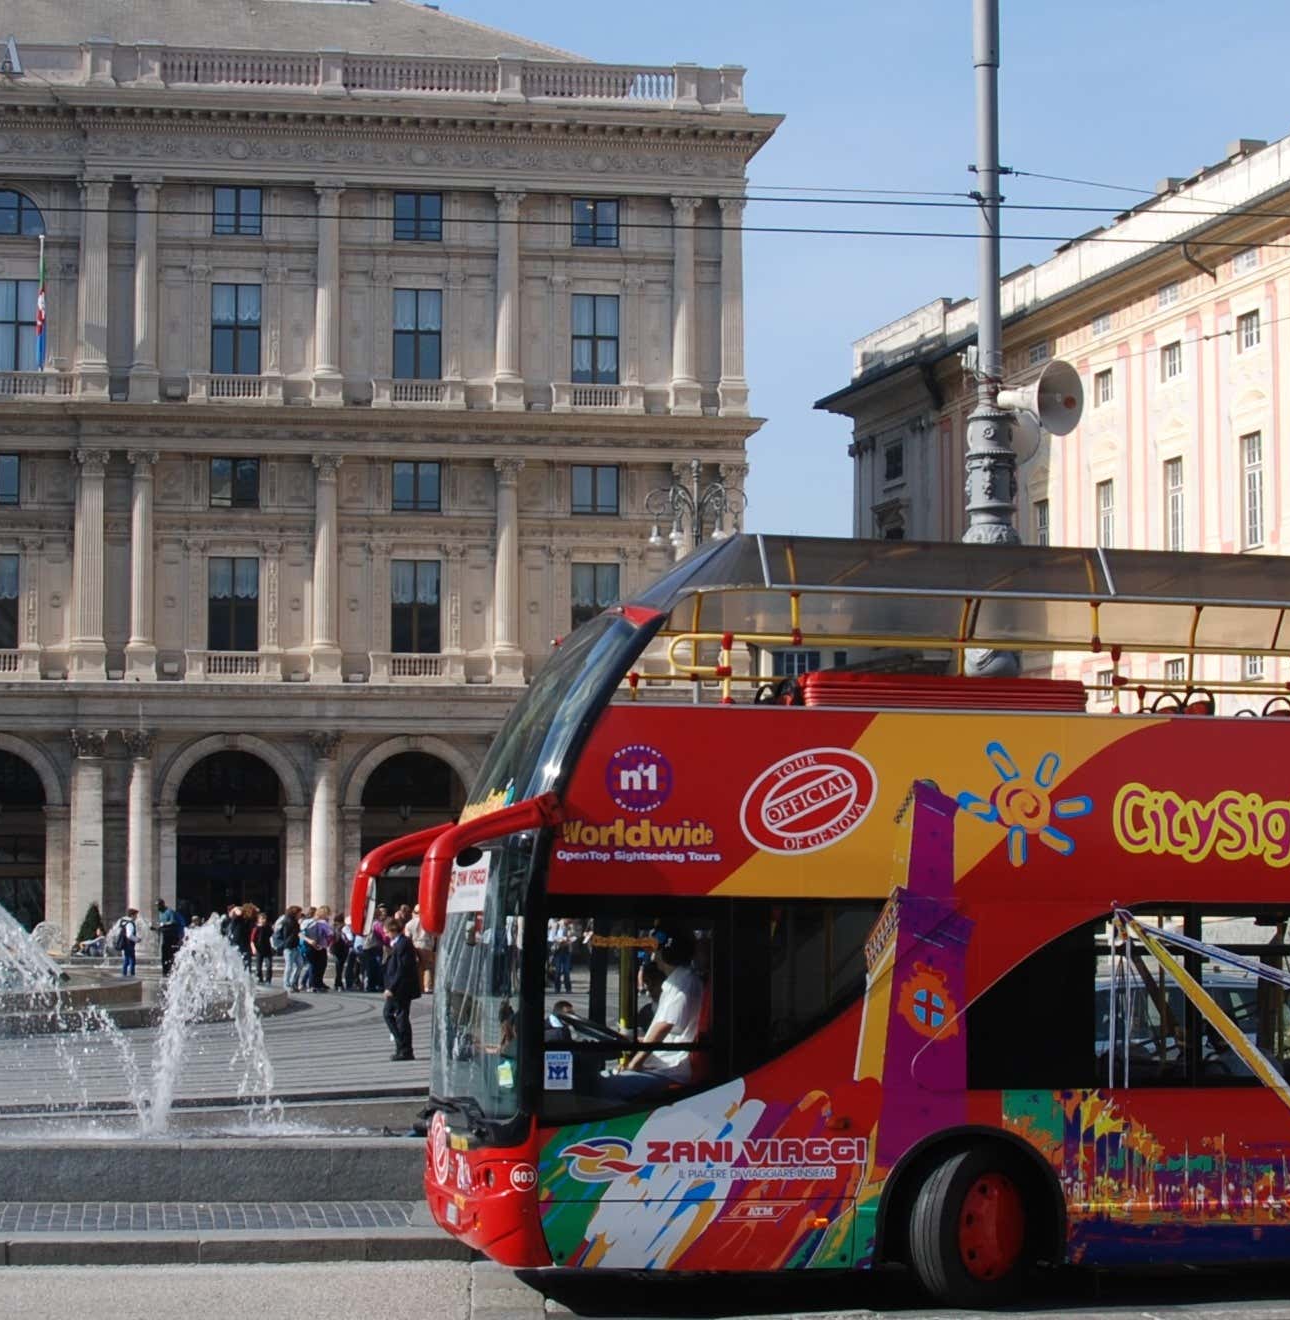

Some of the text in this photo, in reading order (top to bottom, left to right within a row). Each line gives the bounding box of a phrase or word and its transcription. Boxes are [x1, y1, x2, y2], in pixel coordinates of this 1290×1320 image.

[773, 755, 818, 780] TOUR
[766, 774, 853, 824] OFFICIAL
[562, 818, 715, 848] Worldwide
[783, 802, 866, 850] OF GENOVA
[613, 850, 686, 863] Sightseeing
[687, 851, 722, 862] Tours
[646, 1138, 869, 1165] ZANI VIAGGI
[513, 1170, 535, 1184] 603
[687, 1168, 728, 1179] PIACERE
[730, 1168, 741, 1179] DI
[742, 1168, 796, 1178] VIAGGIARE
[797, 1167, 836, 1178] INSIEME
